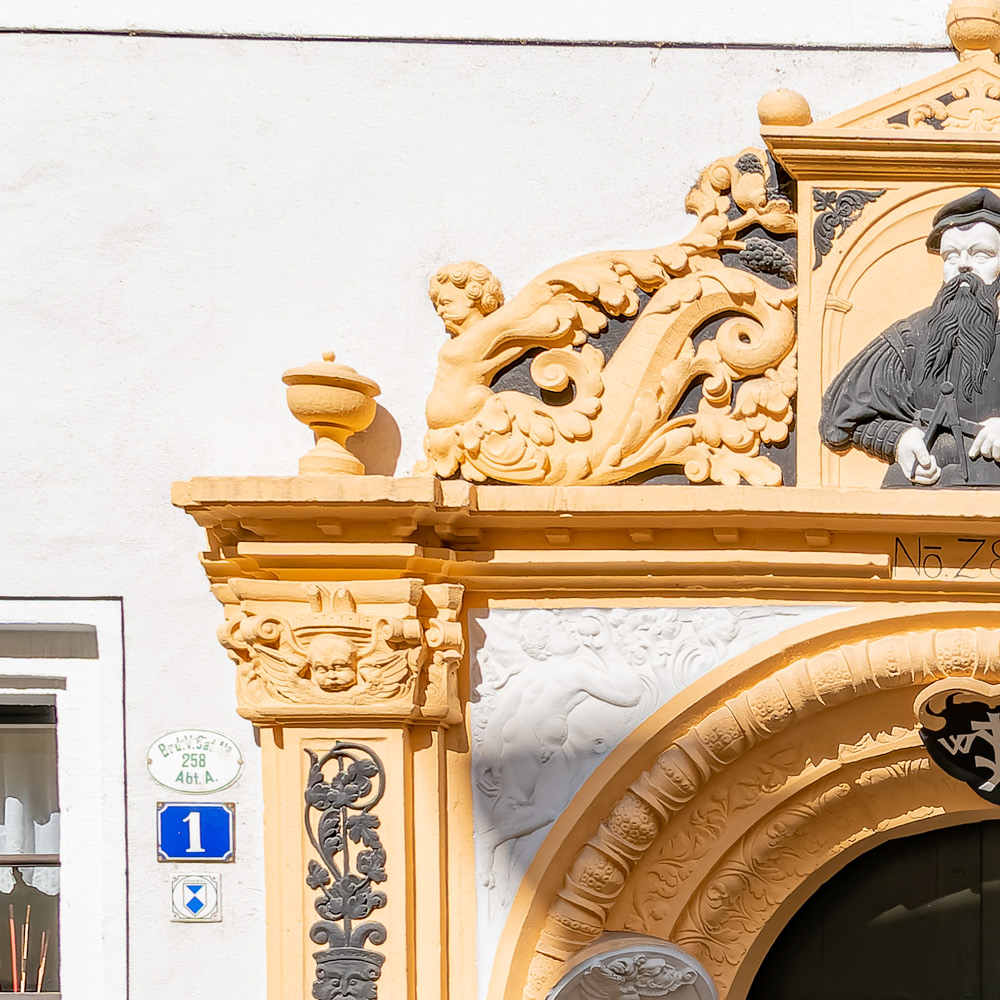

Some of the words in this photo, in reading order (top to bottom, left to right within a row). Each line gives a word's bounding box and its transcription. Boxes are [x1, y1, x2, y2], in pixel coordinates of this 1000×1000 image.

[181, 753, 206, 768] 258
[175, 770, 202, 785] Abt.
[205, 770, 219, 784] A.
[182, 811, 206, 853] 1
